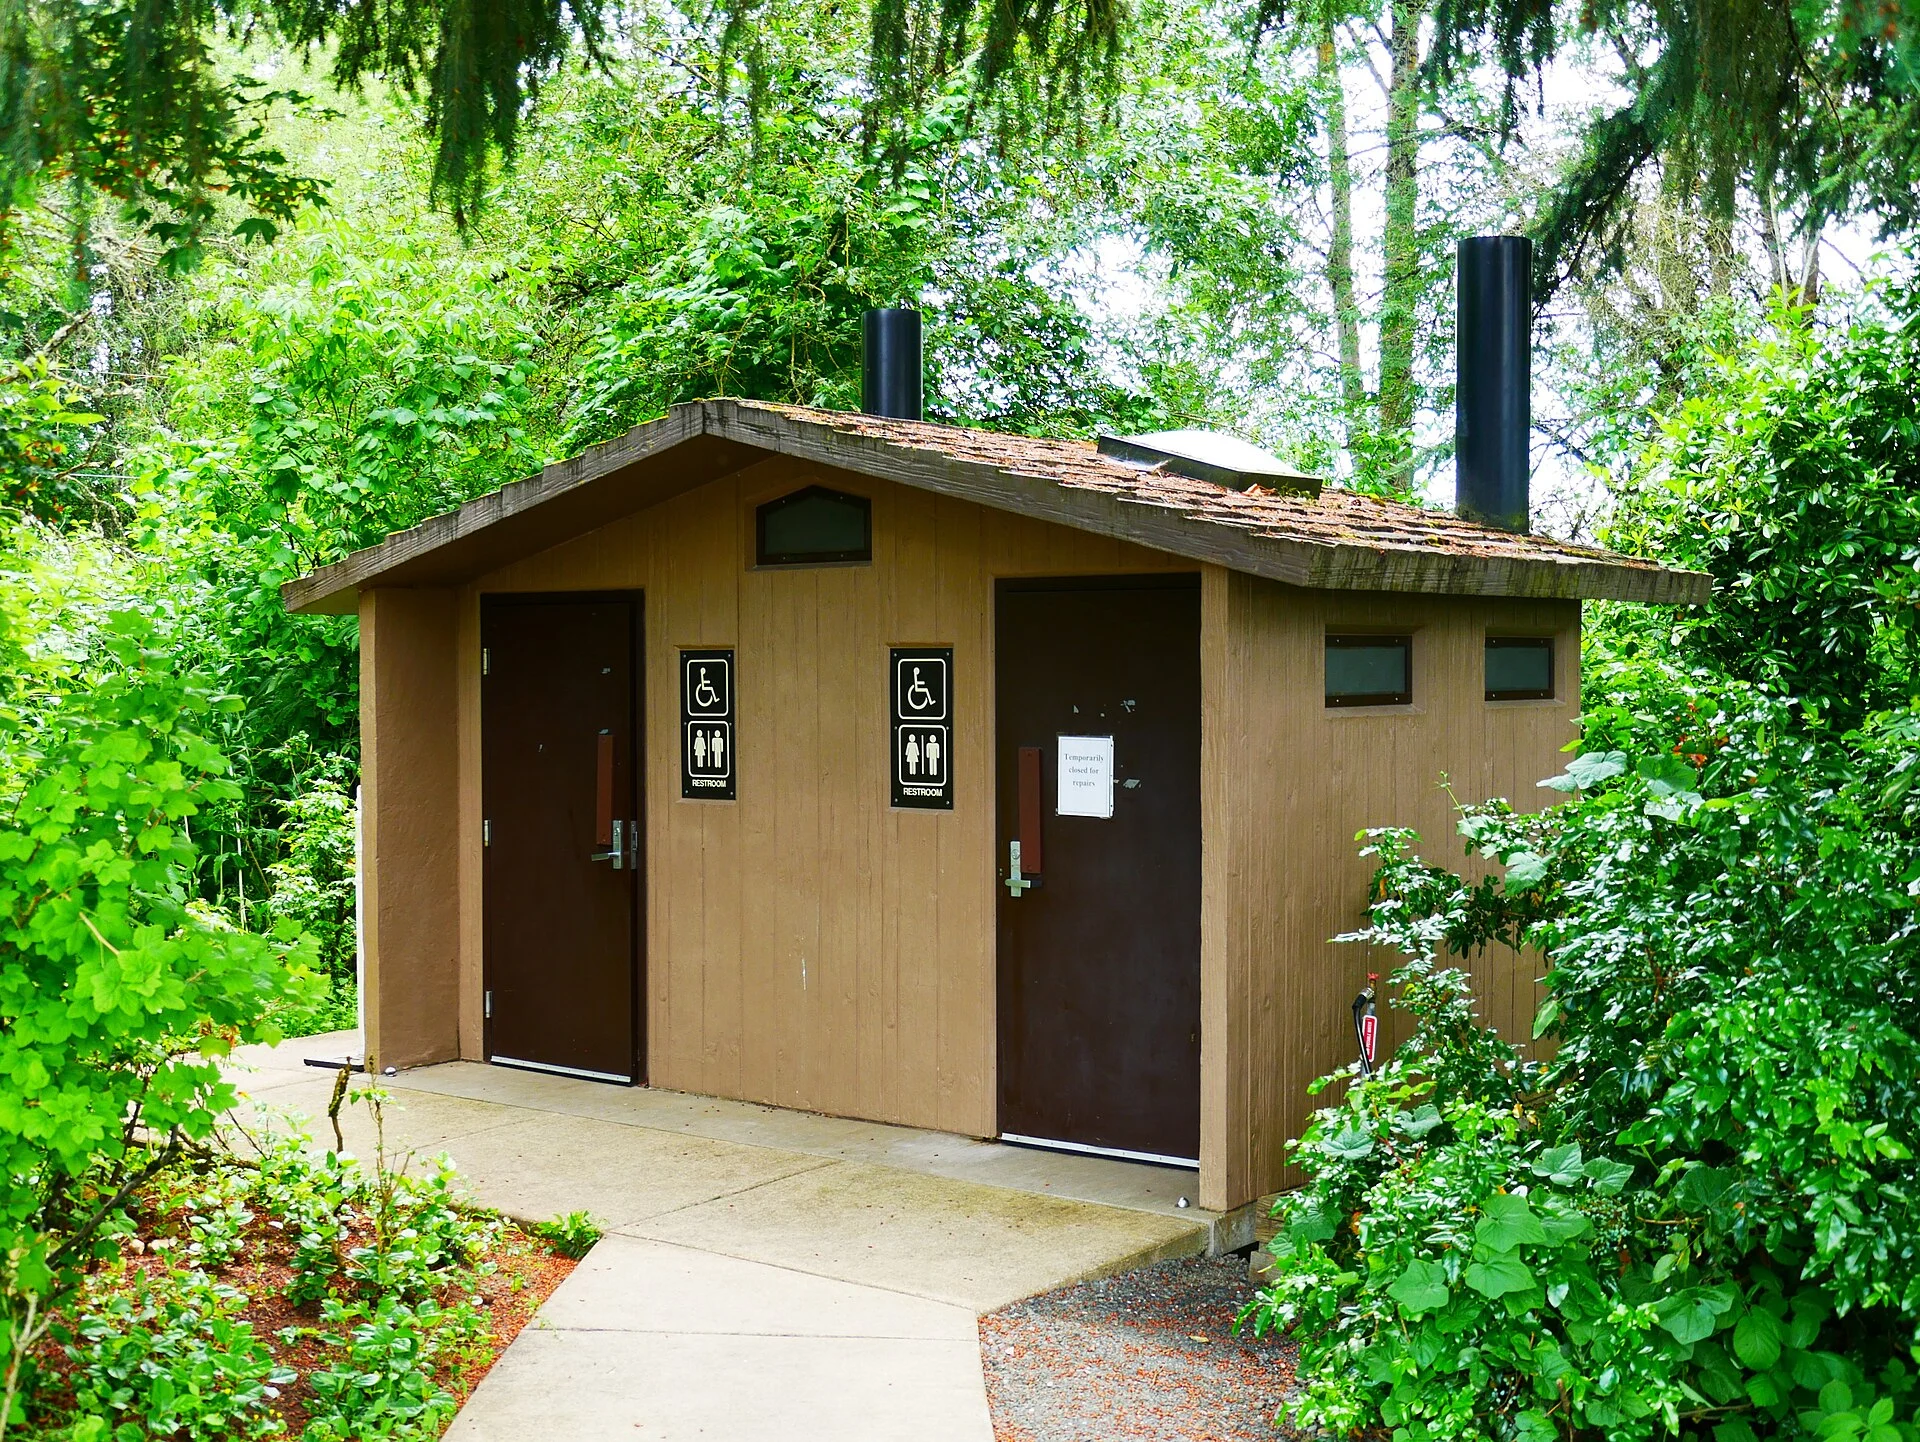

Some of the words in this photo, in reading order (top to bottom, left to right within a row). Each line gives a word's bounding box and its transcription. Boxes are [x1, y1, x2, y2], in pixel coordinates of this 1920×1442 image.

[1064, 753, 1104, 763] Temporarily
[1068, 766, 1088, 774] closed
[1089, 766, 1099, 774] for
[692, 779, 727, 788] RESTROOM
[1072, 780, 1096, 788] repairs
[903, 787, 943, 797] RESTROOM
